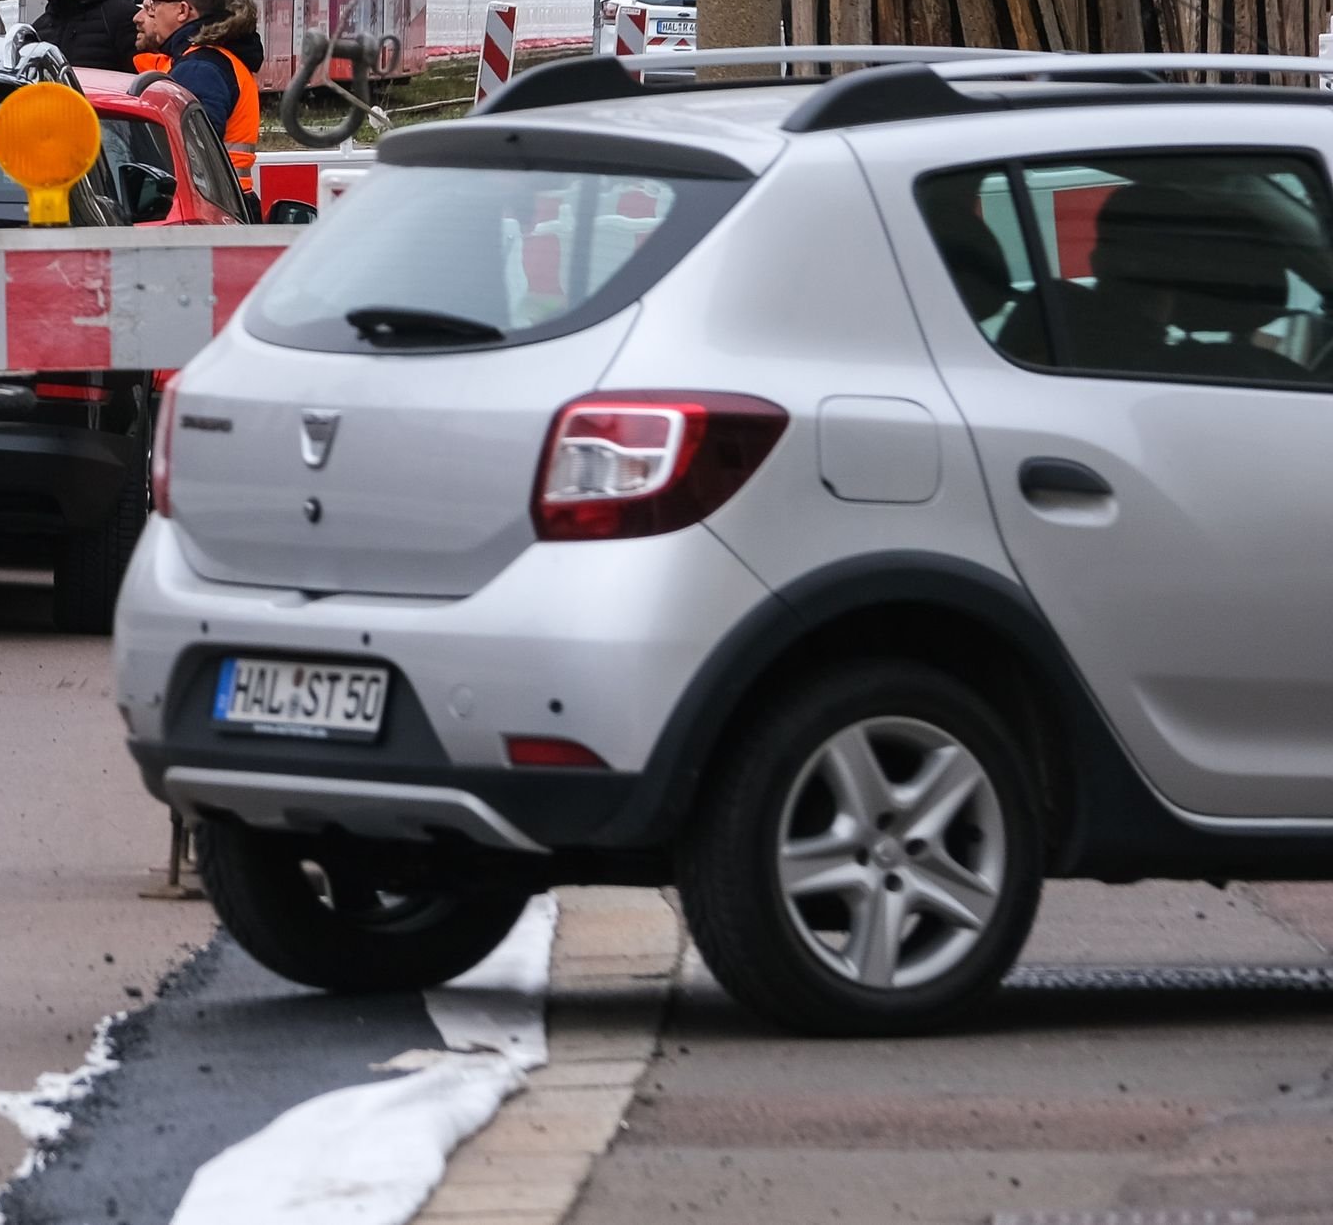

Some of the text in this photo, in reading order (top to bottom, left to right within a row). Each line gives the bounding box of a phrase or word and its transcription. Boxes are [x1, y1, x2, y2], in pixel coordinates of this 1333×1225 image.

[230, 666, 382, 722] HAL ST 50
